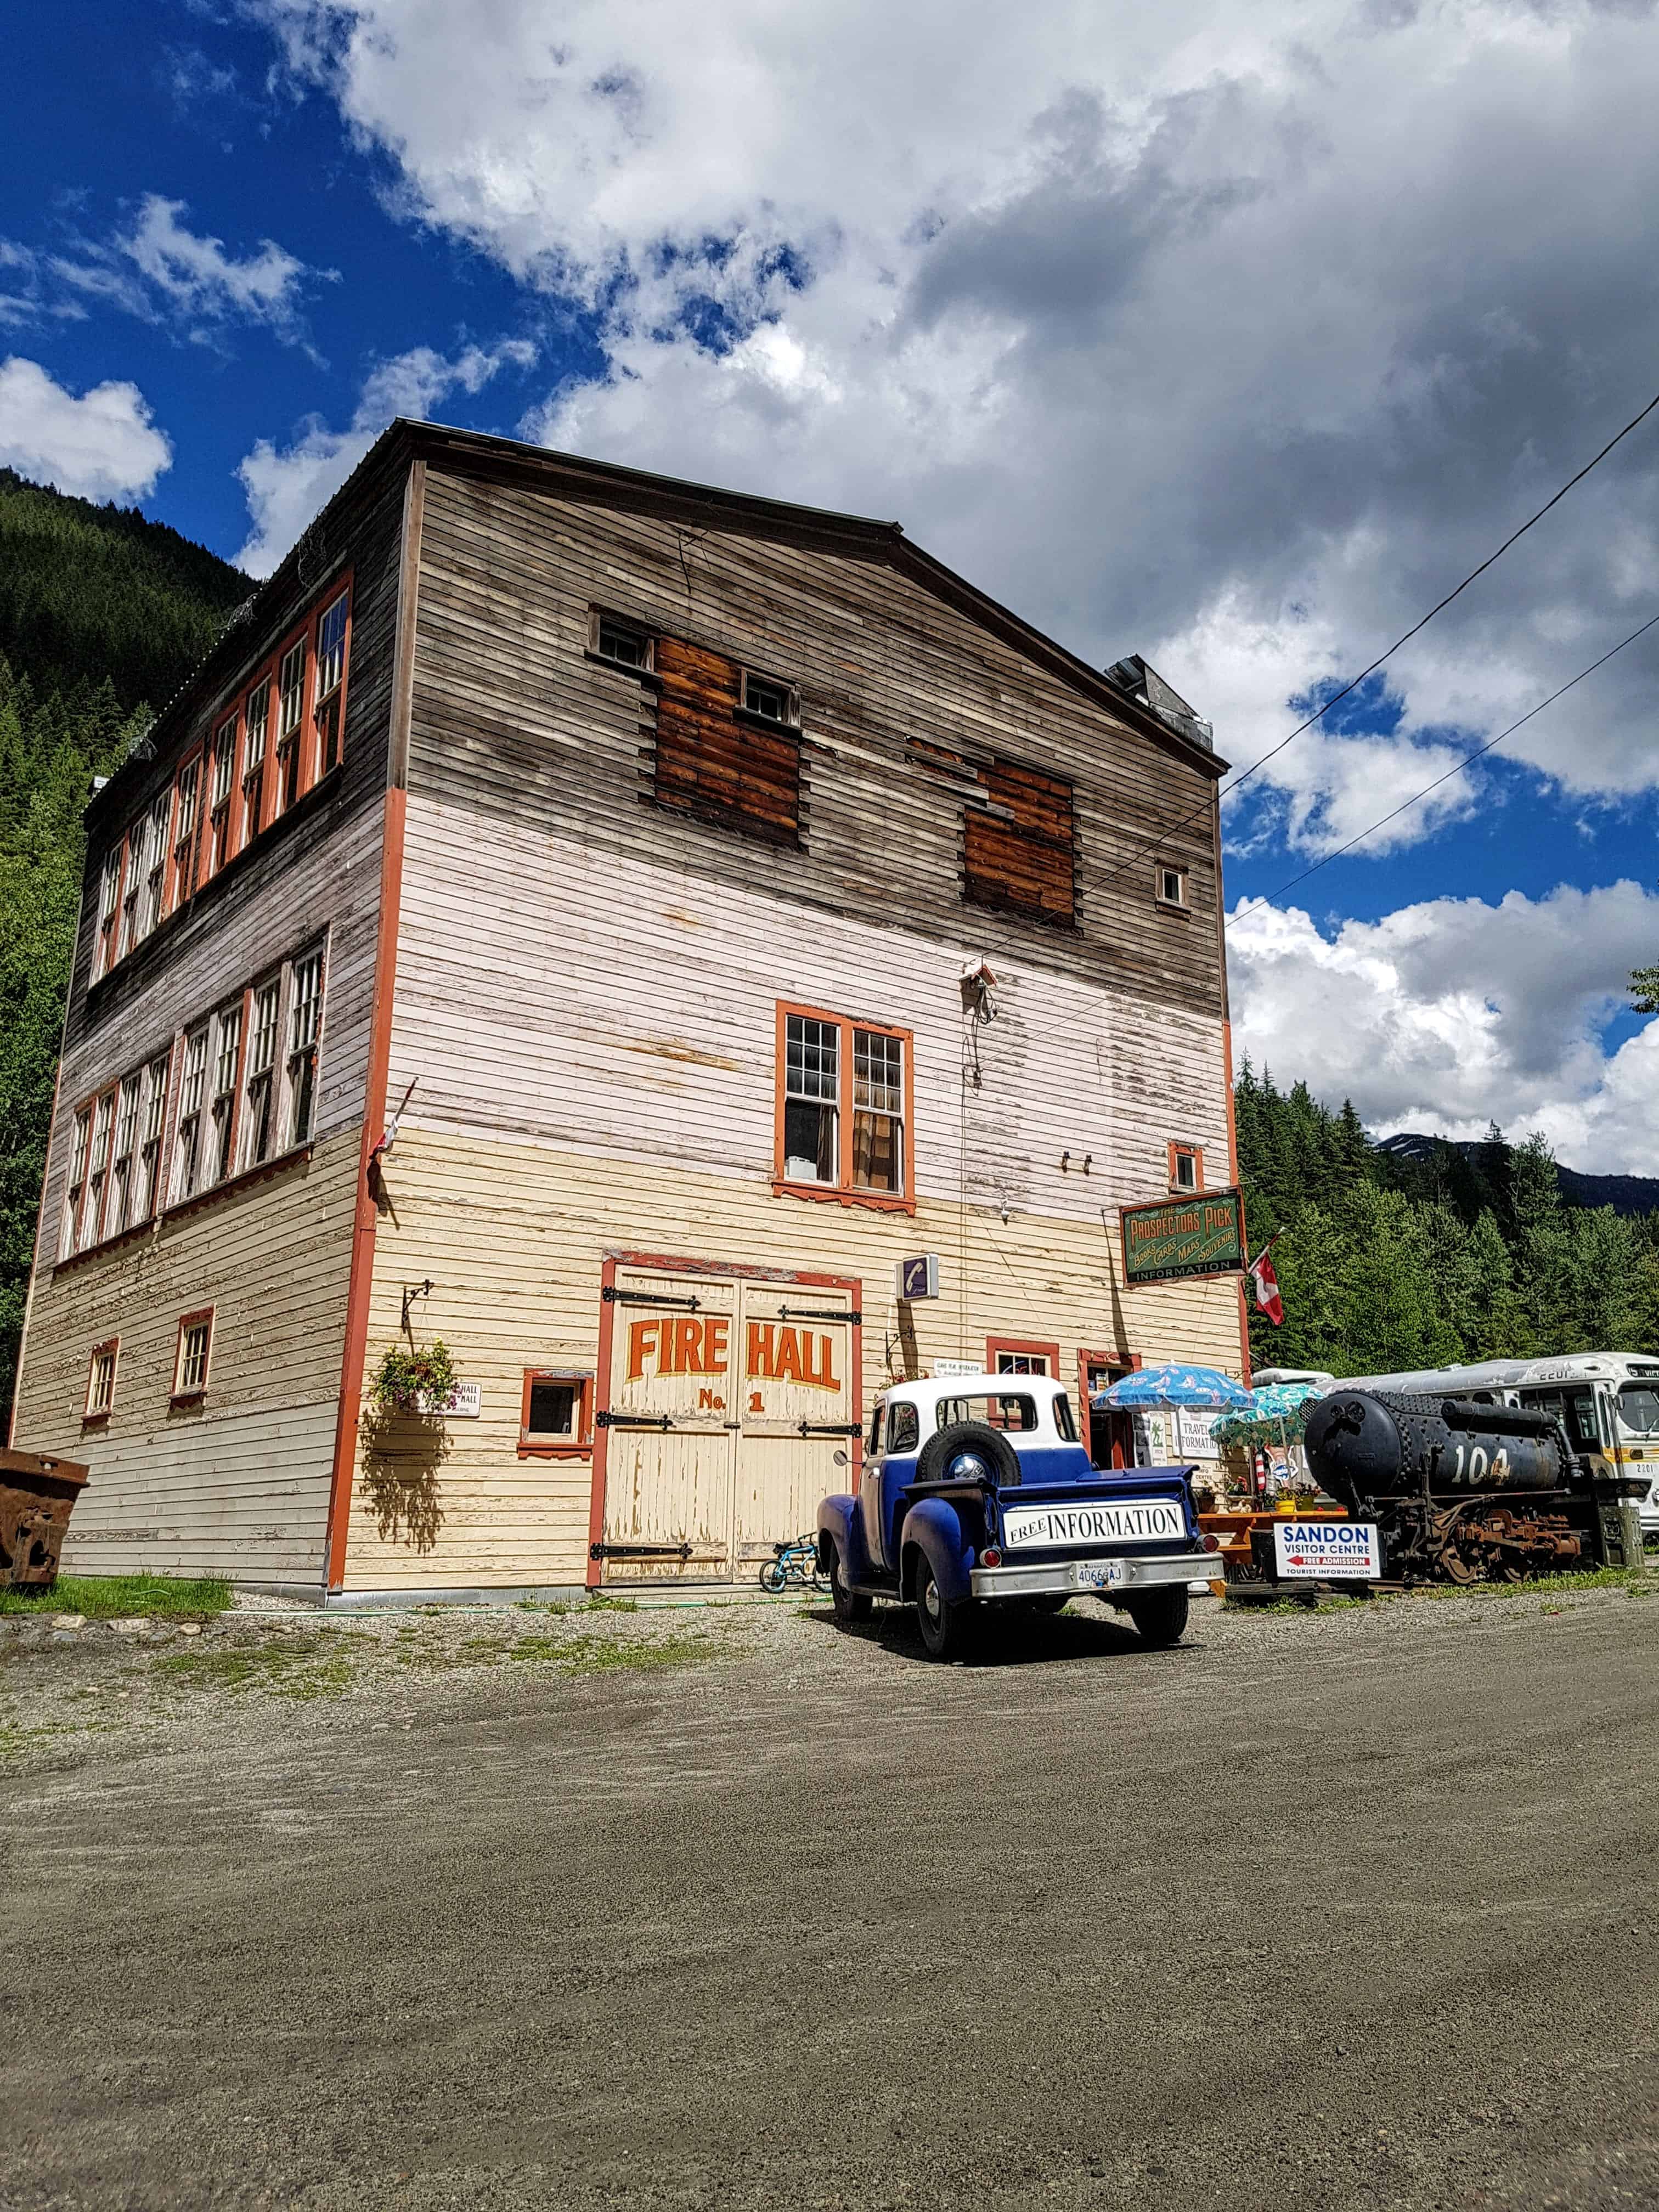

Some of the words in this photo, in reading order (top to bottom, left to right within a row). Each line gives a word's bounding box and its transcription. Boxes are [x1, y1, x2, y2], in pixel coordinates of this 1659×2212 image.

[1160, 1206, 1176, 1217] THE
[1204, 1206, 1233, 1238] PICK
[1134, 1242, 1156, 1267] BOOKS
[1153, 1239, 1177, 1265] CARDS
[1178, 1238, 1200, 1262] MAPS
[1198, 1228, 1235, 1262] SOUVENIRS
[1136, 1261, 1230, 1281] INFORMATION
[625, 1318, 729, 1382] FIRE
[746, 1322, 841, 1393] HALL
[699, 1389, 726, 1409] No.
[749, 1392, 765, 1412] 1
[1451, 1445, 1510, 1486] 104
[1637, 1464, 1654, 1472] 2201
[1010, 1518, 1047, 1542] FREE
[1047, 1508, 1180, 1539] INFORMATION
[1283, 1526, 1369, 1543] SANDON
[1285, 1544, 1325, 1554] VISITOR
[1329, 1545, 1370, 1554] CENTRE
